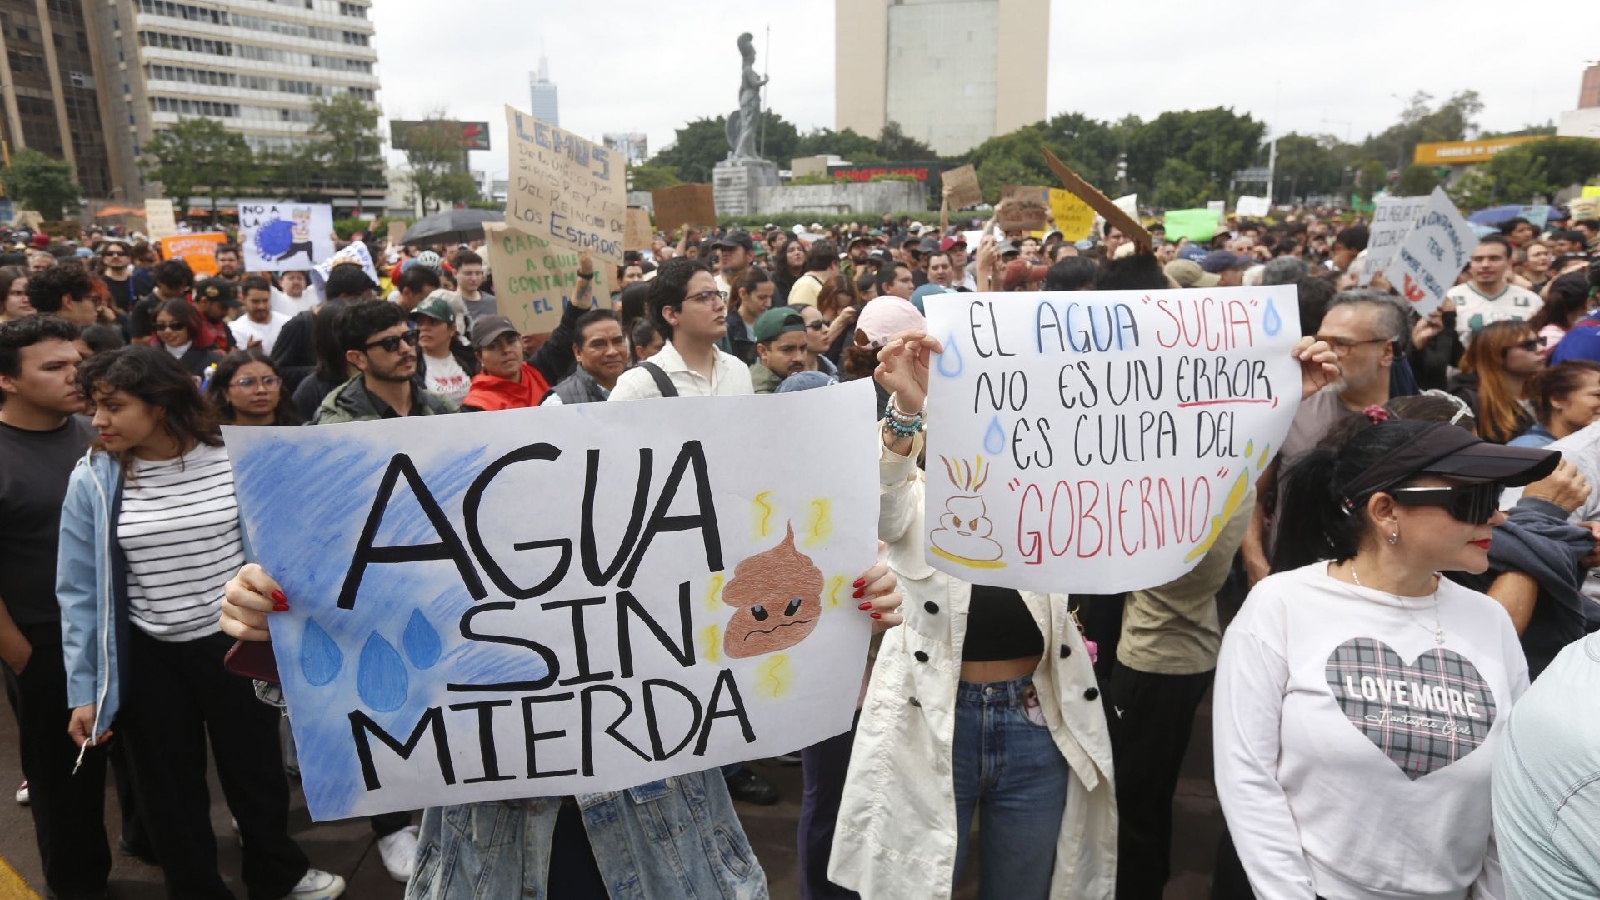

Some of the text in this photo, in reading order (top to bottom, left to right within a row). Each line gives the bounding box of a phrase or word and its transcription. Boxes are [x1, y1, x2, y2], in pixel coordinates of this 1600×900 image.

[515, 111, 610, 180] LEMUS
[243, 206, 264, 215] NO
[243, 218, 260, 228] LA
[514, 199, 543, 225] LOS
[518, 176, 543, 200] DEL
[611, 219, 625, 233] DE
[509, 271, 602, 294] CONTAME
[526, 252, 578, 271] A QUIE
[533, 298, 553, 314] EL
[970, 295, 1258, 358] EL AGUA "SUCIA"
[974, 356, 1278, 413] NO ES UN ERROR,
[1012, 411, 1239, 470] ES CULPA DEL
[337, 440, 724, 610] AGUA
[1008, 467, 1229, 565] "GOBIERNO"
[447, 581, 696, 692] SIN
[348, 669, 757, 791] MIERDA
